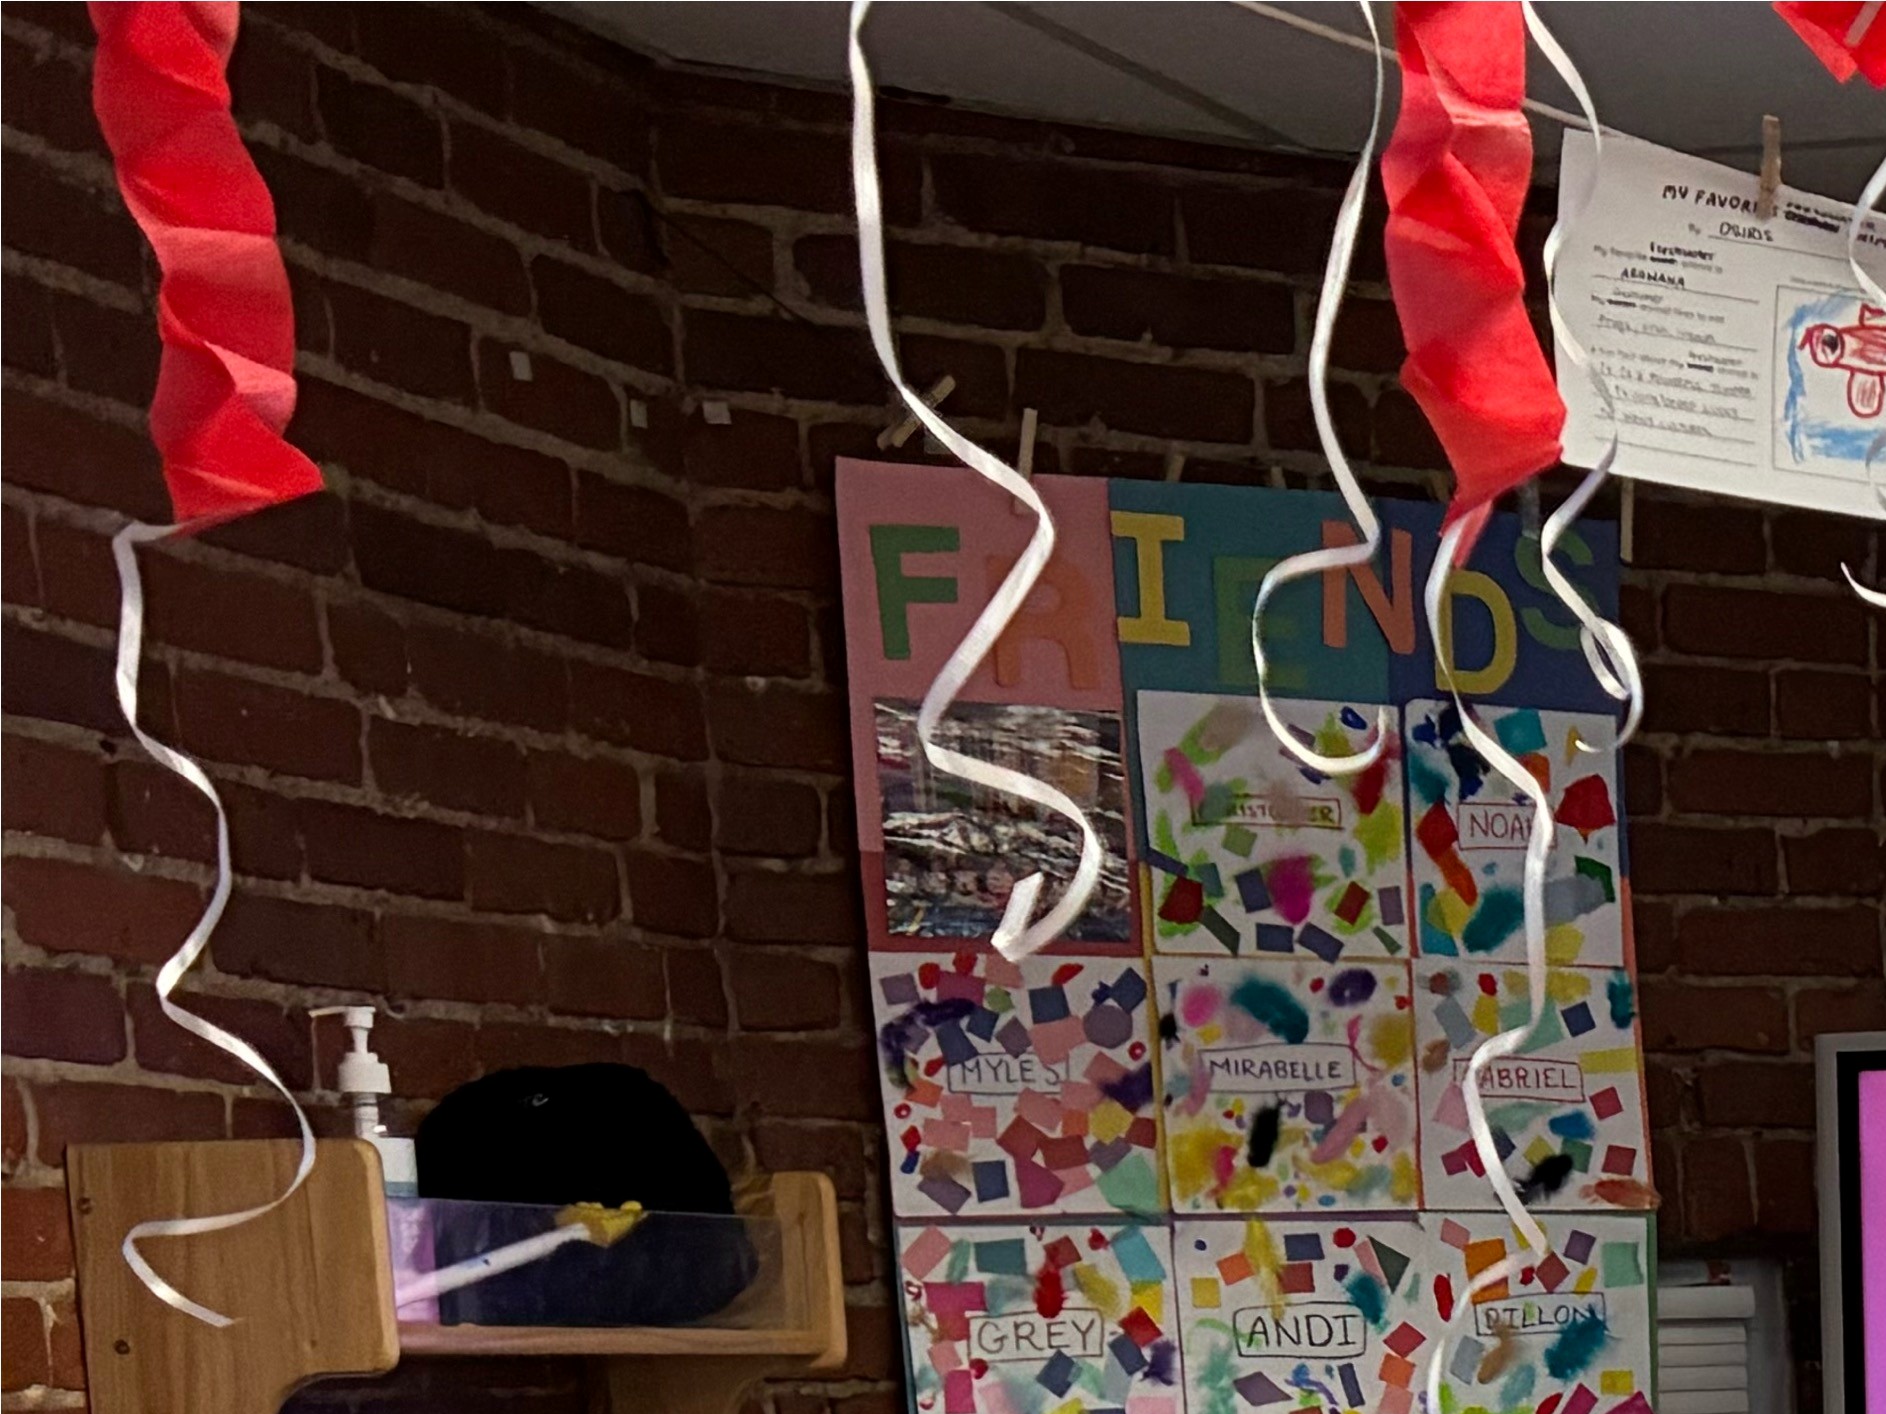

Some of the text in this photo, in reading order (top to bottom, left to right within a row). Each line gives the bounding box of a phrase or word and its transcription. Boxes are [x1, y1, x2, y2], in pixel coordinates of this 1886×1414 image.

[1662, 185, 1688, 200] MY
[869, 509, 1602, 694] FRIENDS
[1209, 1056, 1343, 1084] MIRABELLE
[1476, 1064, 1579, 1091] ABRIEL
[976, 1317, 1096, 1354] GREY
[1247, 1313, 1357, 1351] ANDI
